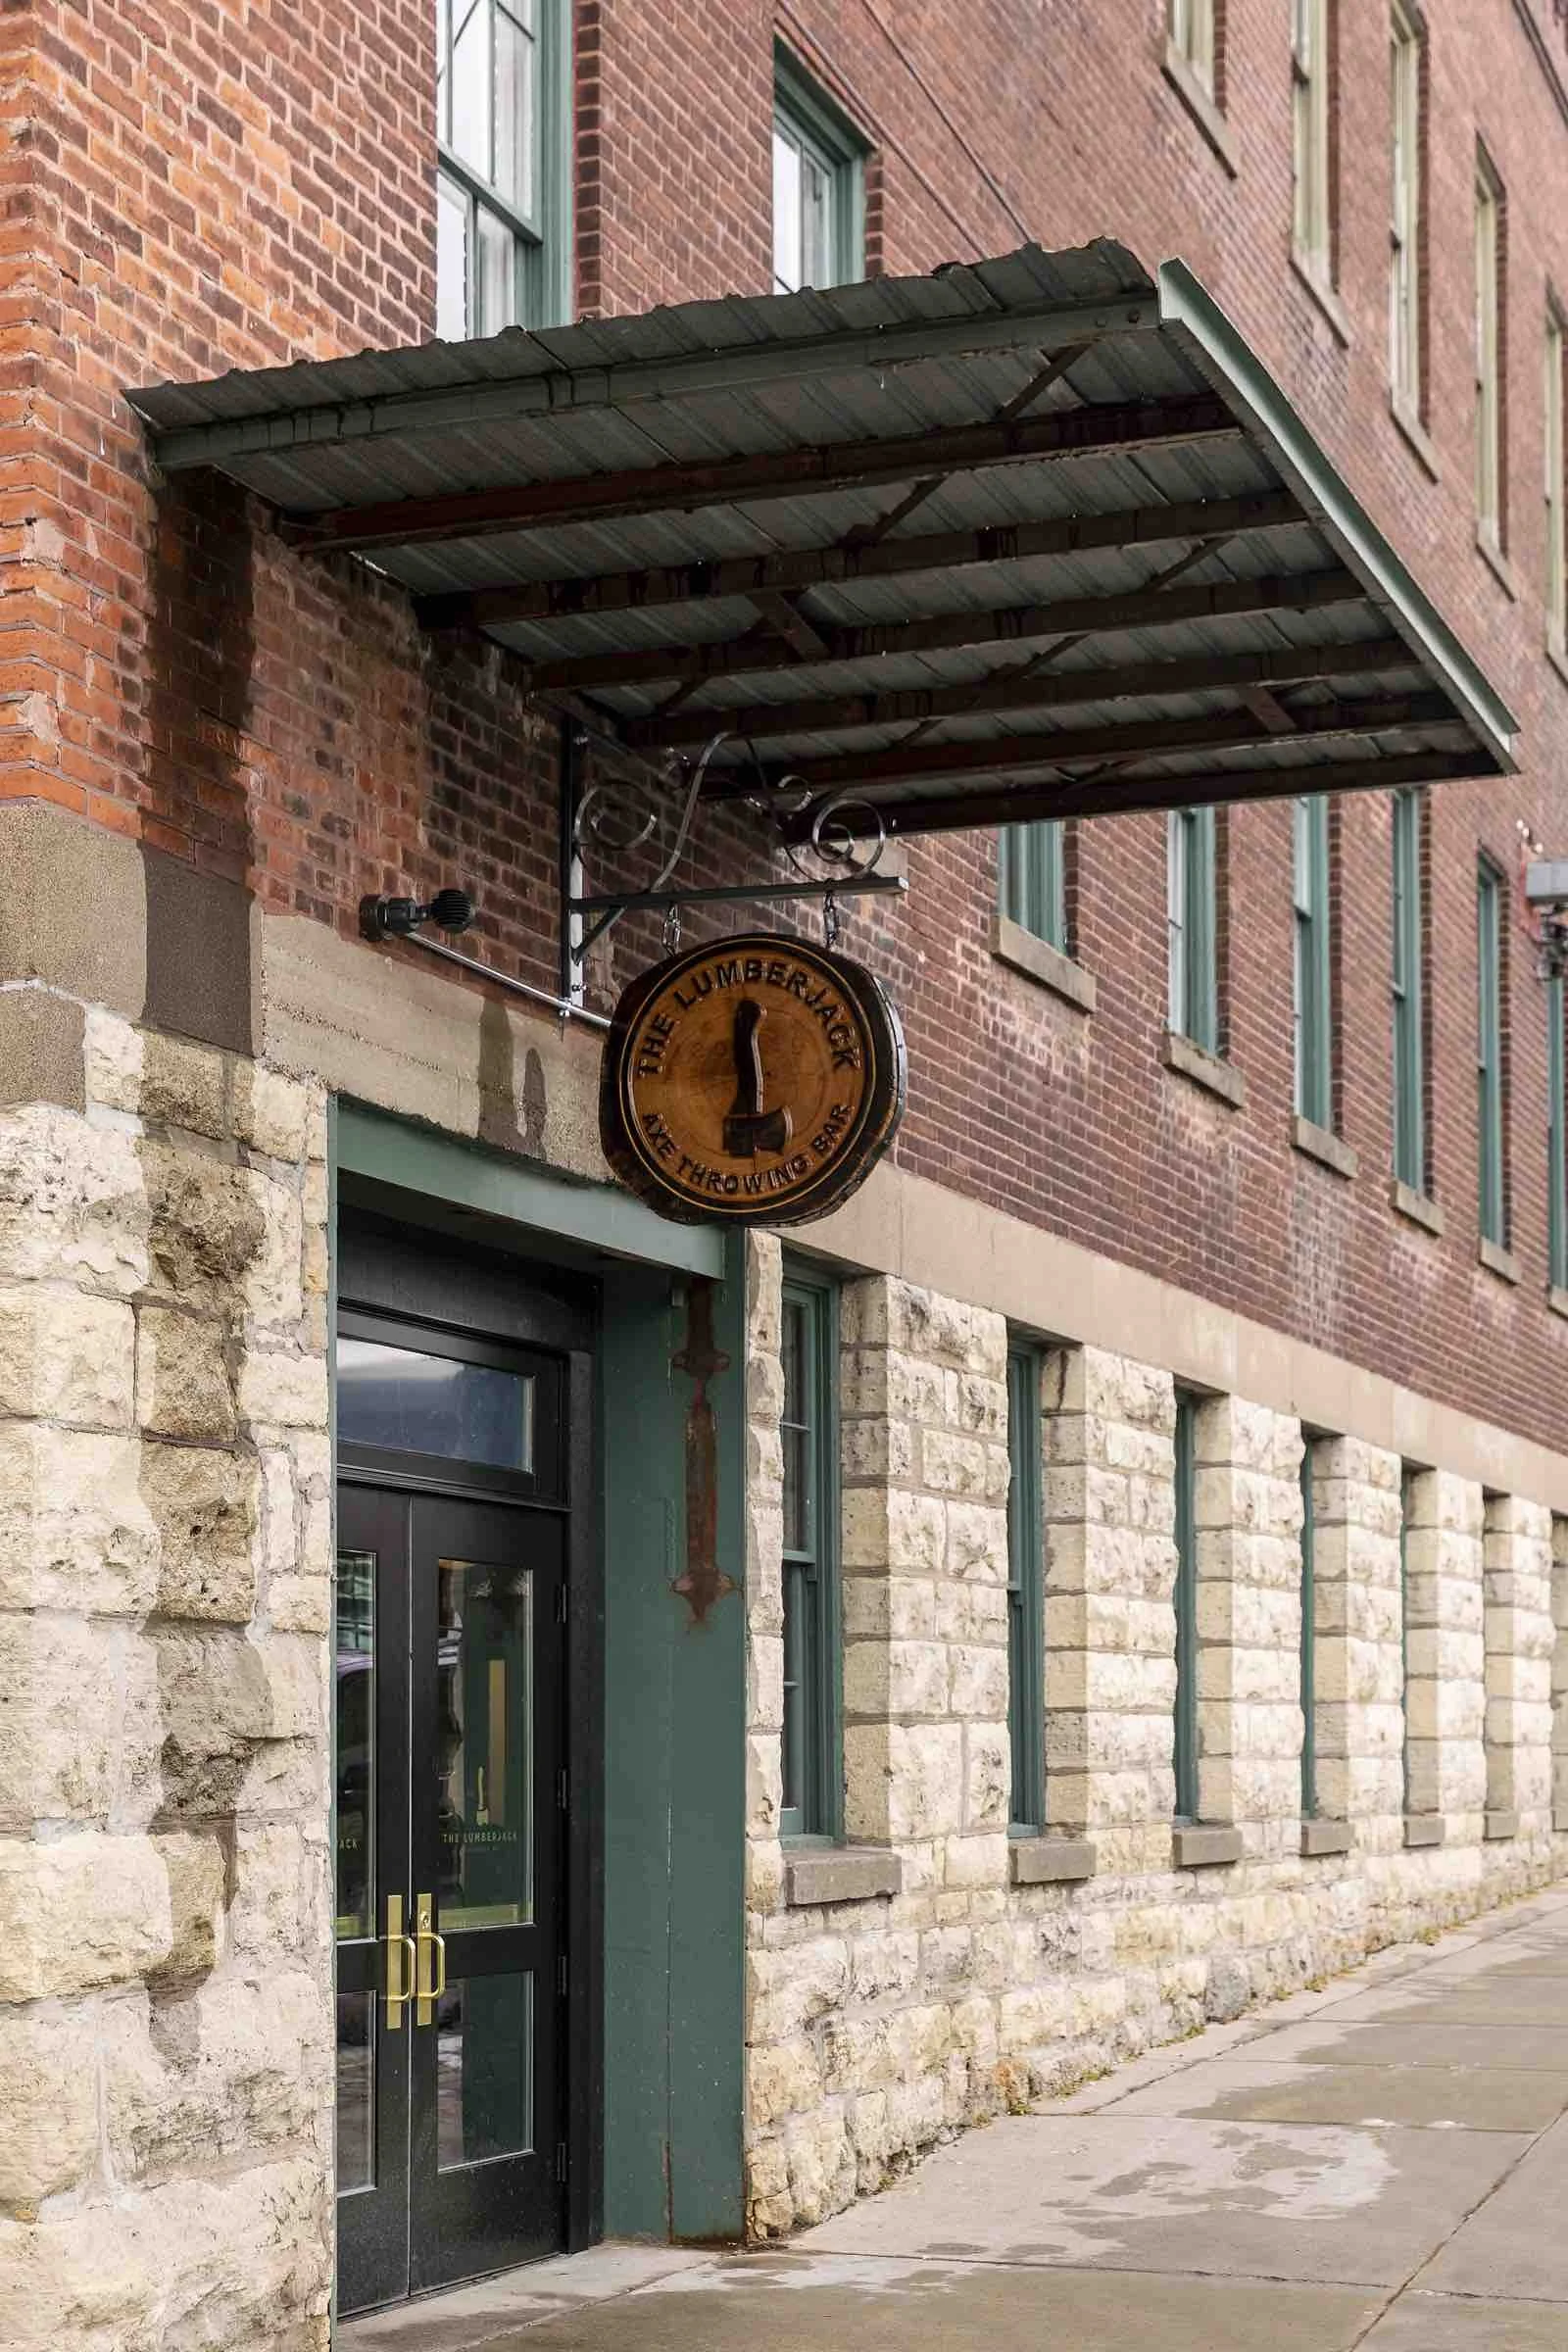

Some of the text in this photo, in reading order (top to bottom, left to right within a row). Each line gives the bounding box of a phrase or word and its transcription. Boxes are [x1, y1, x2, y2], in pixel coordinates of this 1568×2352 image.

[639, 957, 861, 1077] THE LUMBERJACK
[642, 1103, 855, 1196] AXE THROWING BAR
